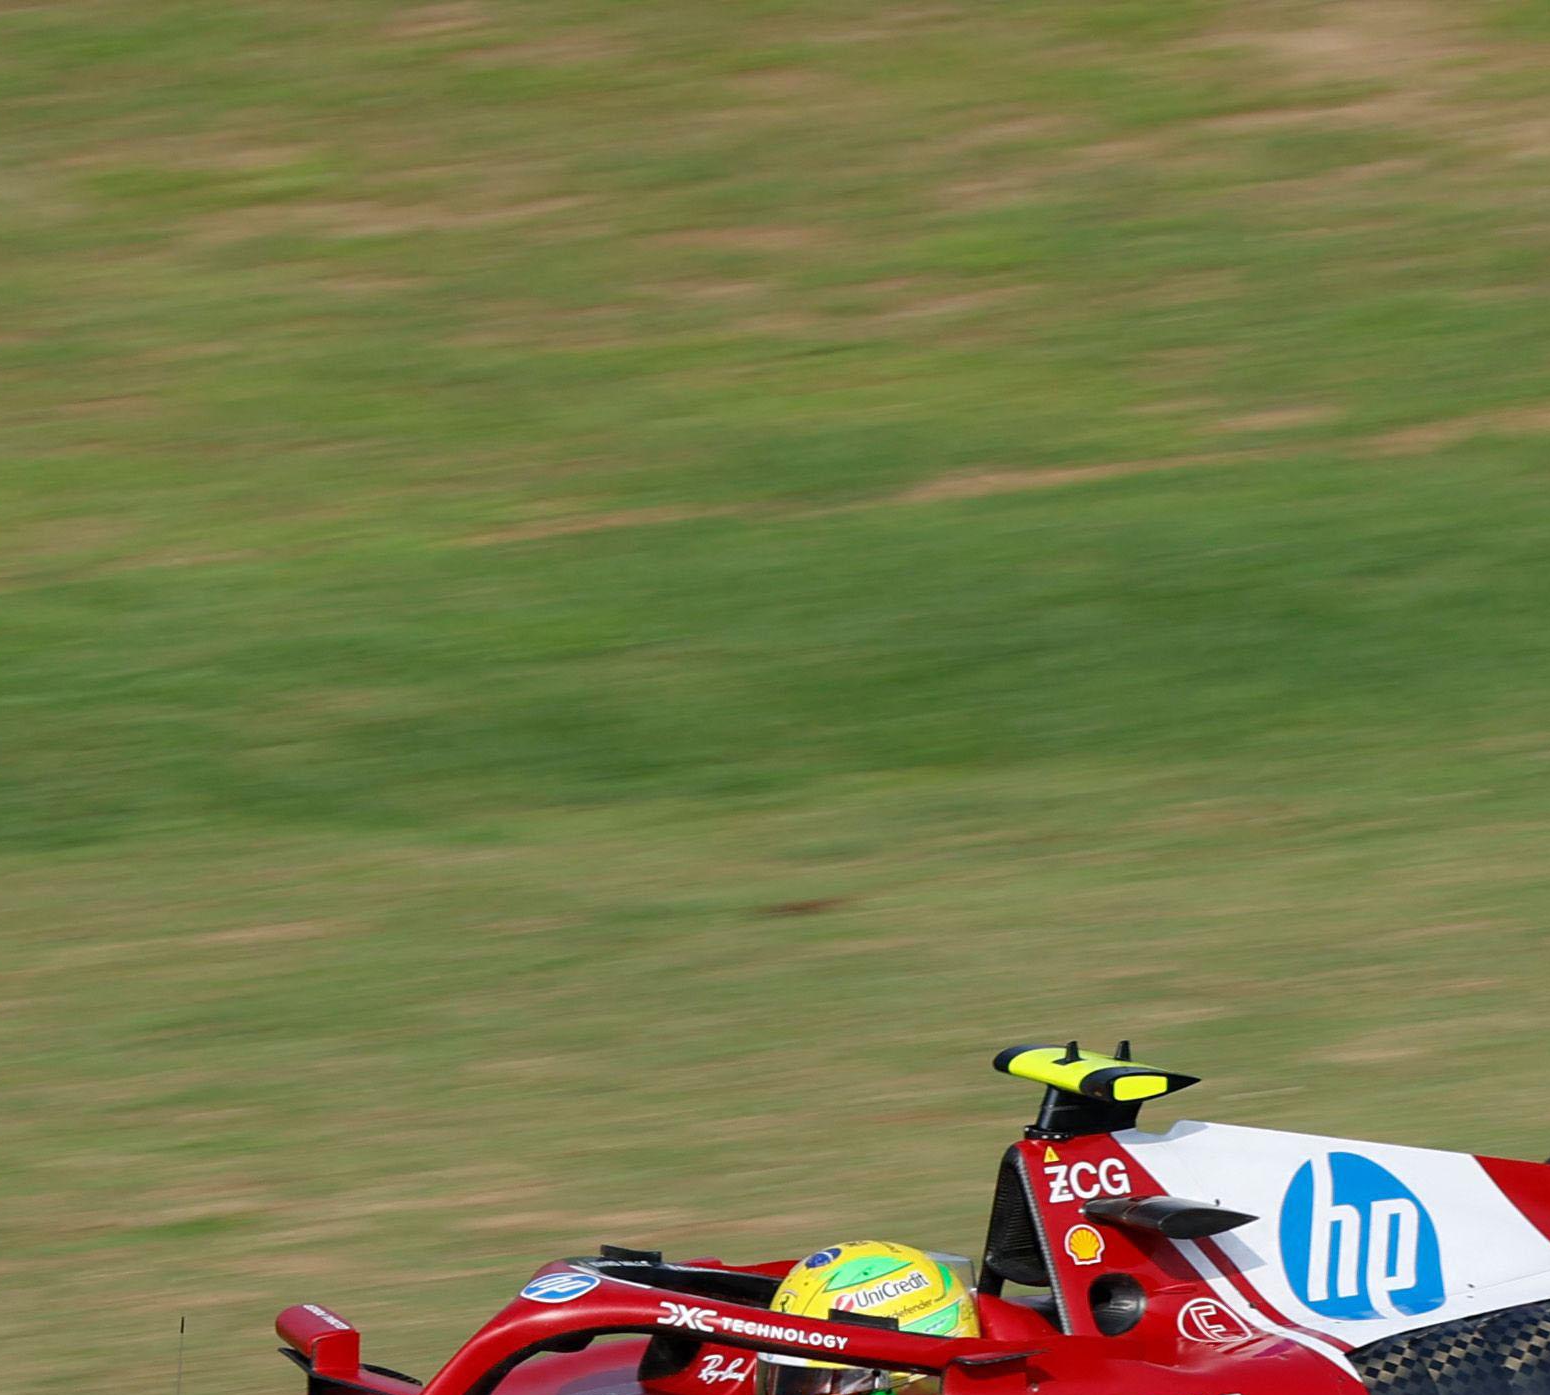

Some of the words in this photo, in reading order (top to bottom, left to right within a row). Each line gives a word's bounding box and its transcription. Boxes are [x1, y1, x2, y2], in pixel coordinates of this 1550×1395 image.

[1044, 1158, 1132, 1204] ZCG
[1308, 1152, 1418, 1318] hp
[855, 1271, 929, 1308] UniCredit
[656, 1301, 718, 1333] DXC
[721, 1315, 849, 1350] TECHNOLOGY
